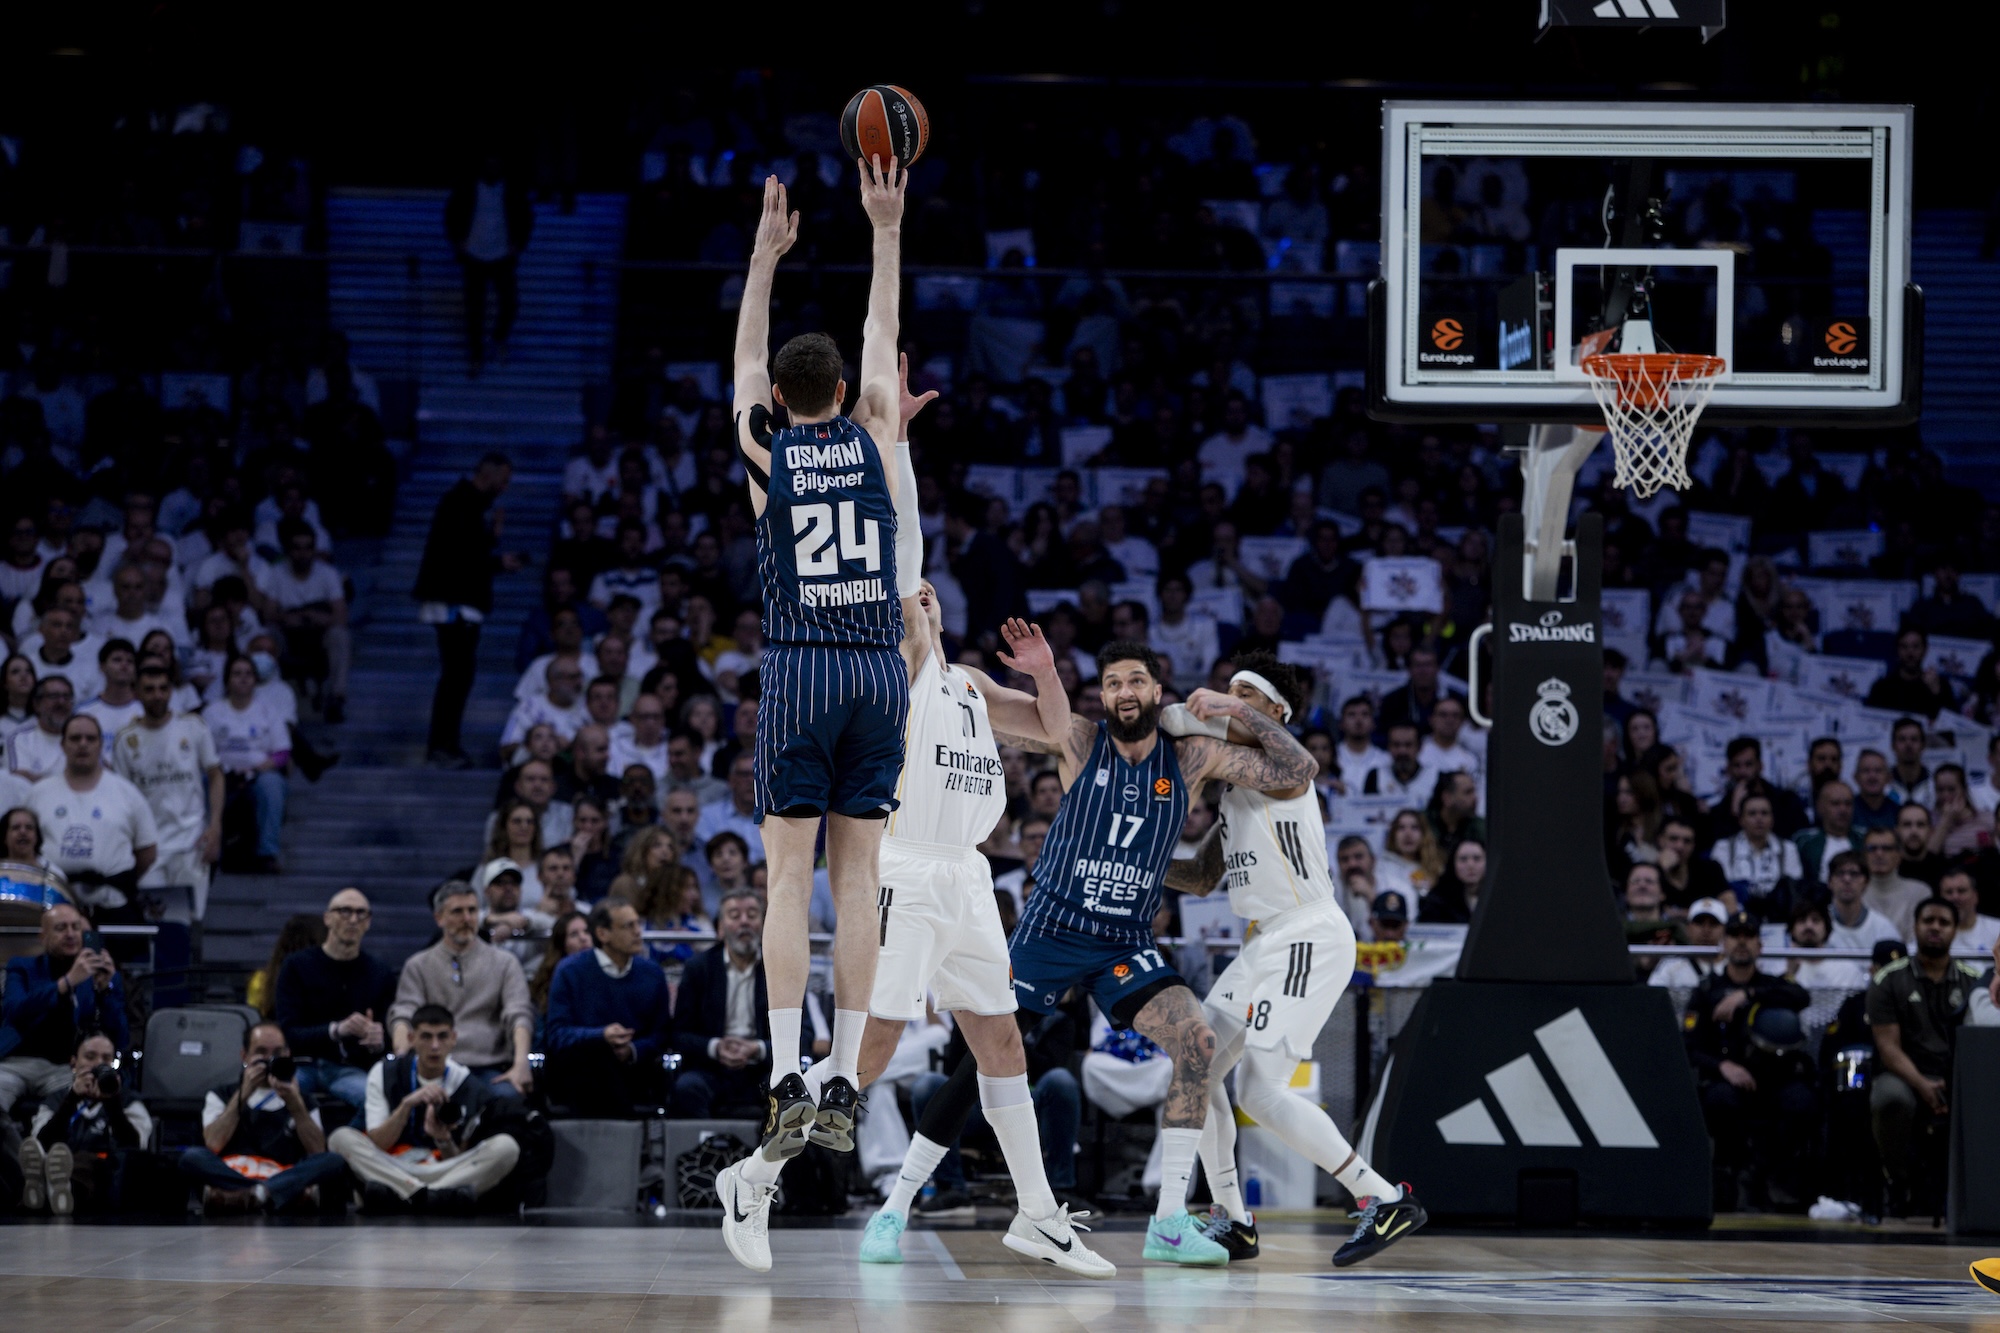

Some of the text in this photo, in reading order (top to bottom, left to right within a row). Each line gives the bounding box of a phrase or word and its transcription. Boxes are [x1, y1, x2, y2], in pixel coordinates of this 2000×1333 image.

[1420, 351, 1475, 365] EuroLeague
[1813, 356, 1869, 369] EuroLeague
[792, 470, 865, 496] Bilyoner
[790, 500, 881, 577] 24
[1508, 622, 1595, 643] SPALDING
[935, 744, 1003, 776] Emirates
[945, 772, 992, 796] FLY BETTER
[1107, 812, 1145, 849] 17
[1226, 850, 1258, 870] ates
[1074, 858, 1154, 890] ANADOLU
[1227, 870, 1251, 889] ETTER
[1083, 877, 1139, 901] EFES
[1131, 949, 1166, 973] 17
[1254, 999, 1272, 1032] 8
